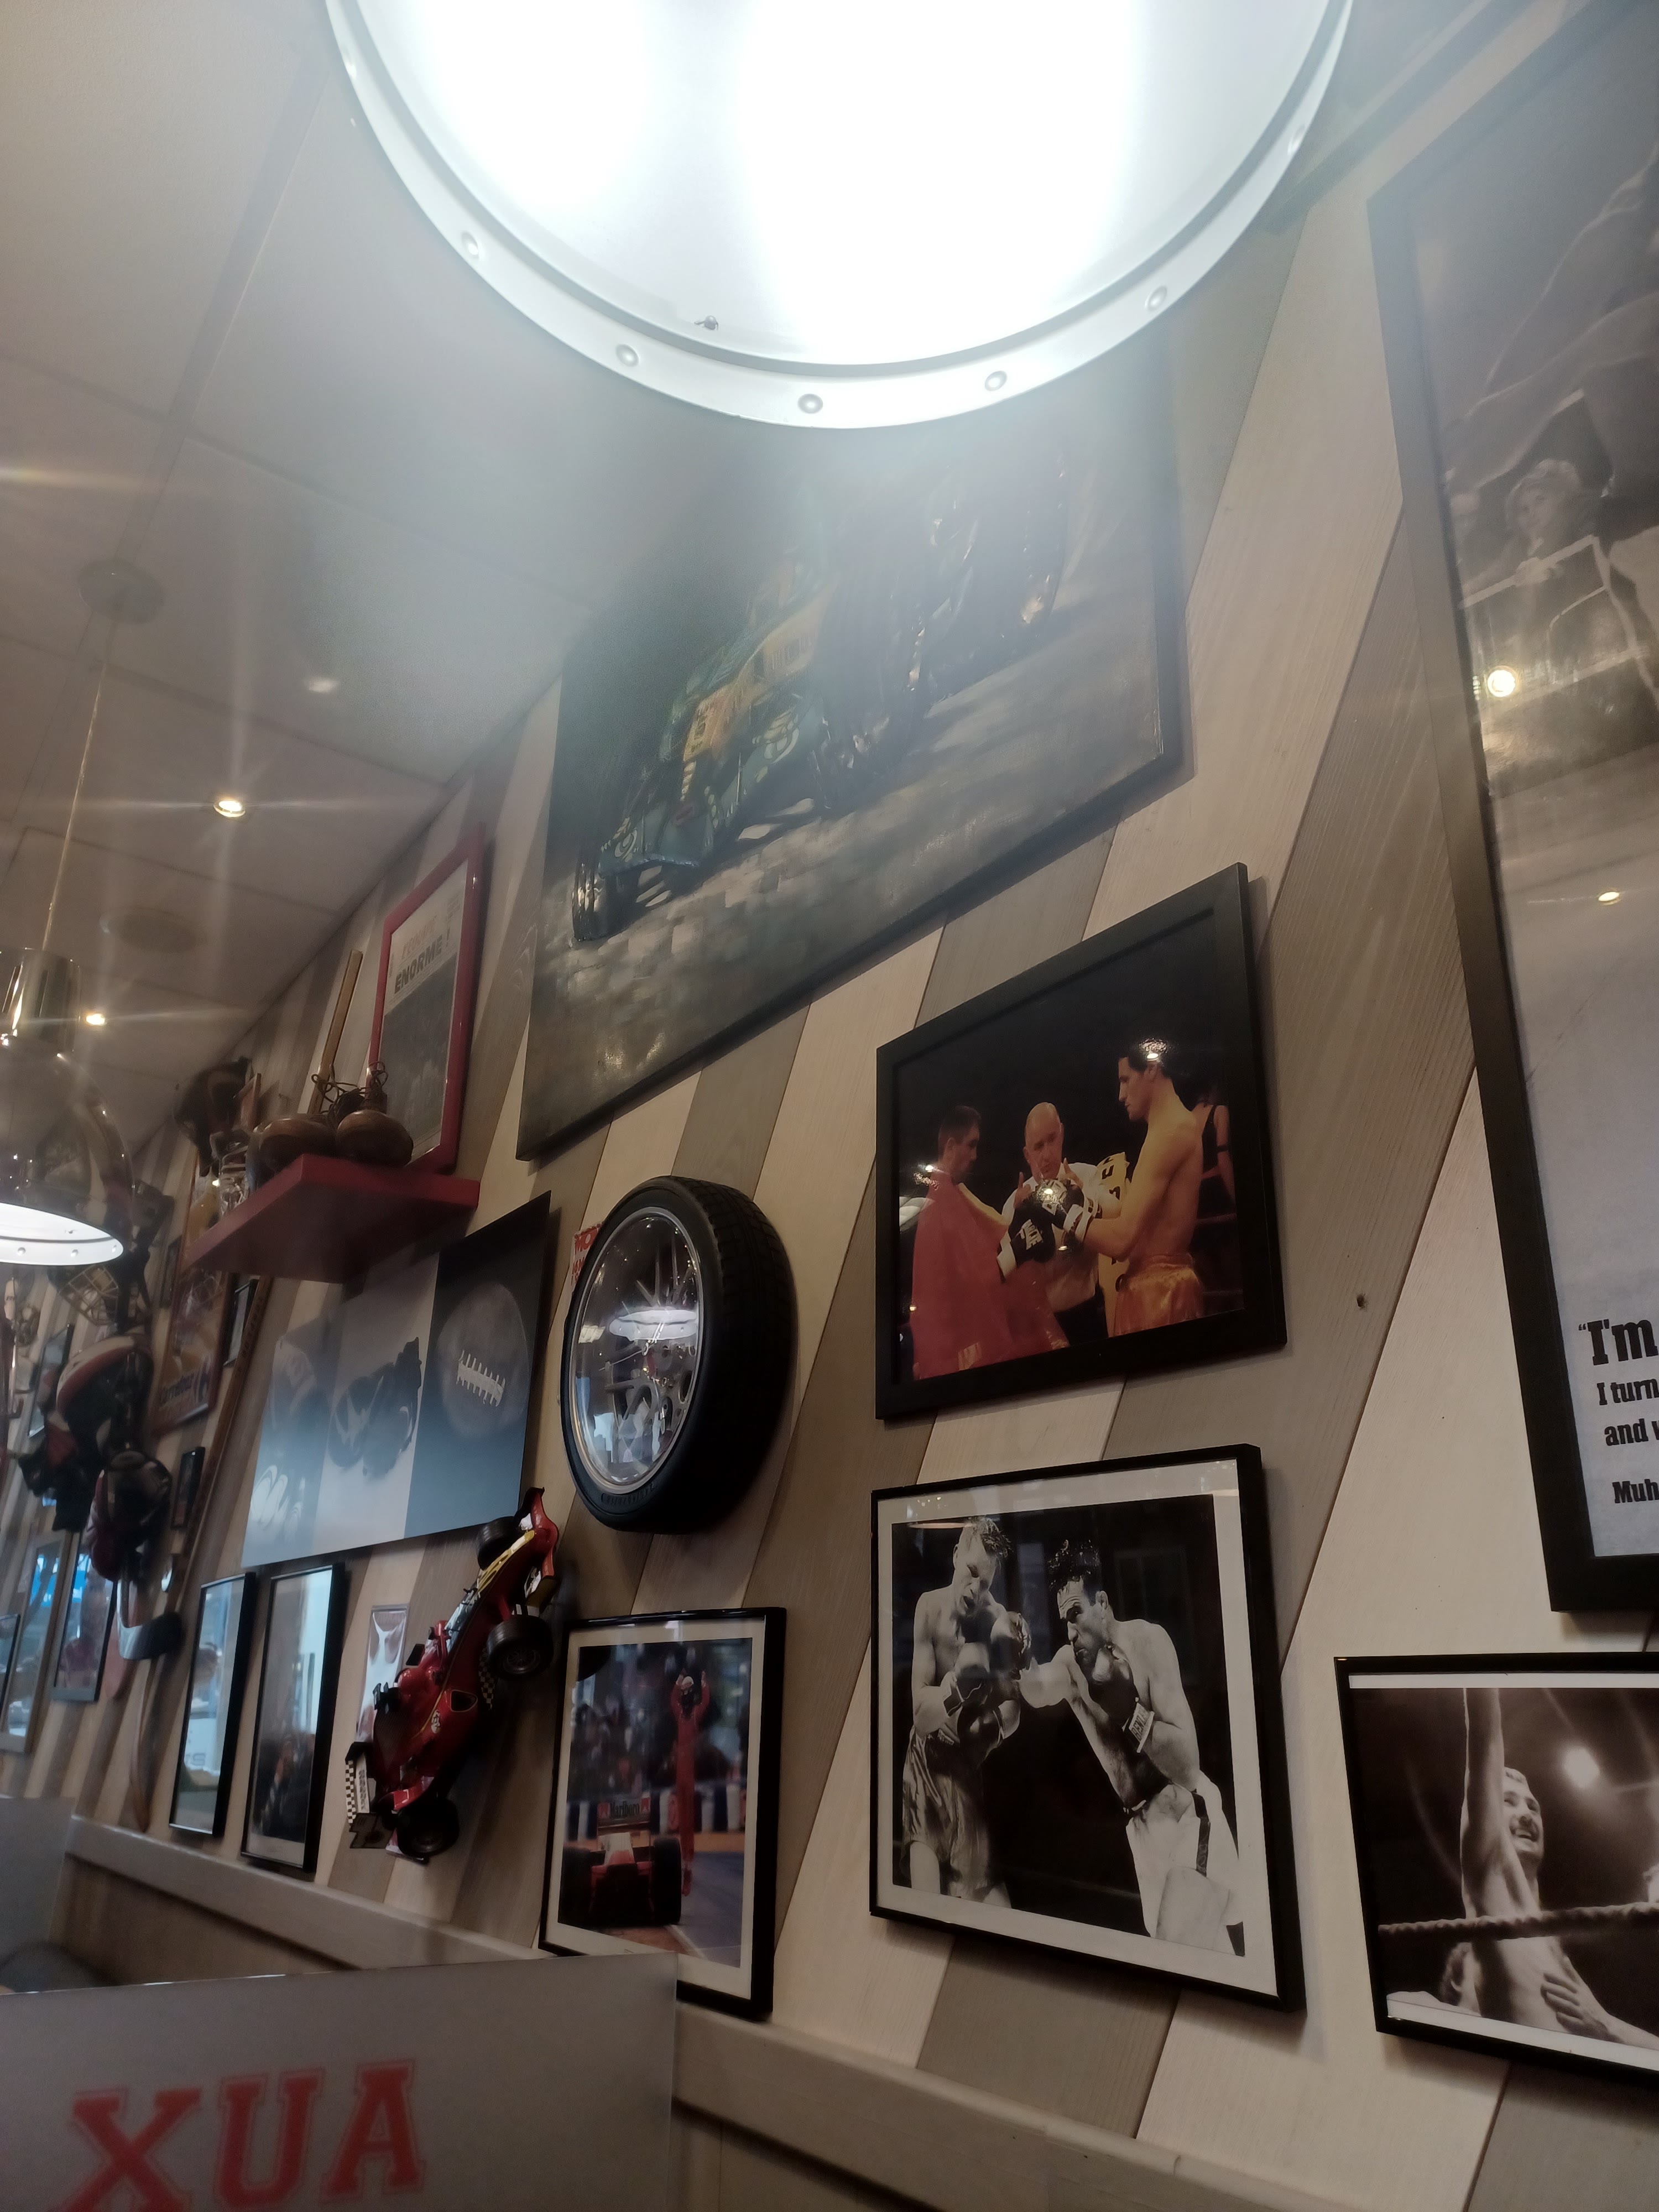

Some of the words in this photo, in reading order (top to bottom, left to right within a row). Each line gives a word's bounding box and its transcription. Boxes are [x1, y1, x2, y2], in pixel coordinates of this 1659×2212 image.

[394, 935, 444, 994] ENORME
[1597, 1382, 1608, 1406] I
[1604, 1418, 1649, 1446] and
